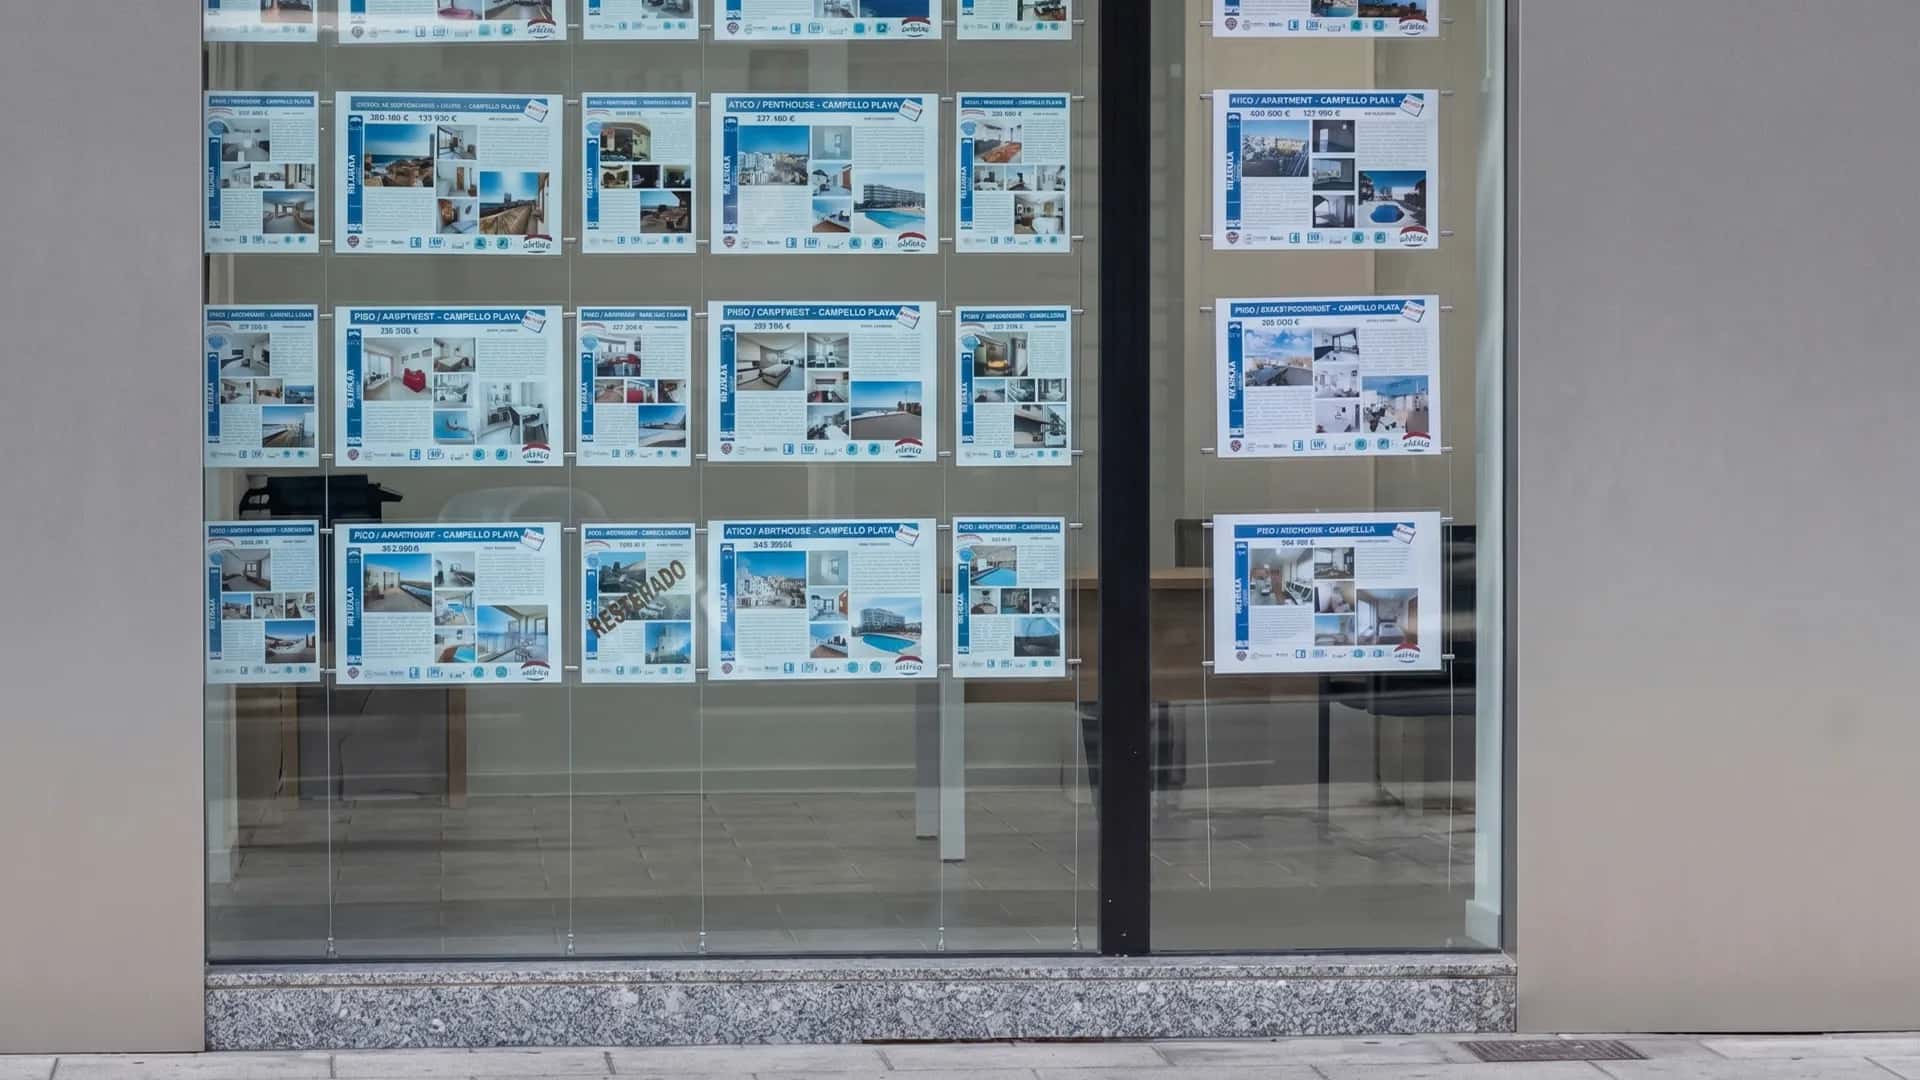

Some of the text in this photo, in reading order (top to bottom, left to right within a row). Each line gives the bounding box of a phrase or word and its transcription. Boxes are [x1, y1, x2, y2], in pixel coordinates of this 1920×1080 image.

[728, 101, 754, 110] ATICO
[763, 101, 814, 109] PENTHOUSE
[822, 101, 869, 110] CAMPELLO
[871, 101, 899, 110] PLAYA
[818, 308, 866, 316] CAMPELLO
[868, 308, 896, 316] PLAYA
[443, 313, 490, 321] CAMPELLO
[493, 313, 521, 321] PLAYA
[726, 528, 752, 536] ATICO
[818, 527, 866, 535] CAMPELLO
